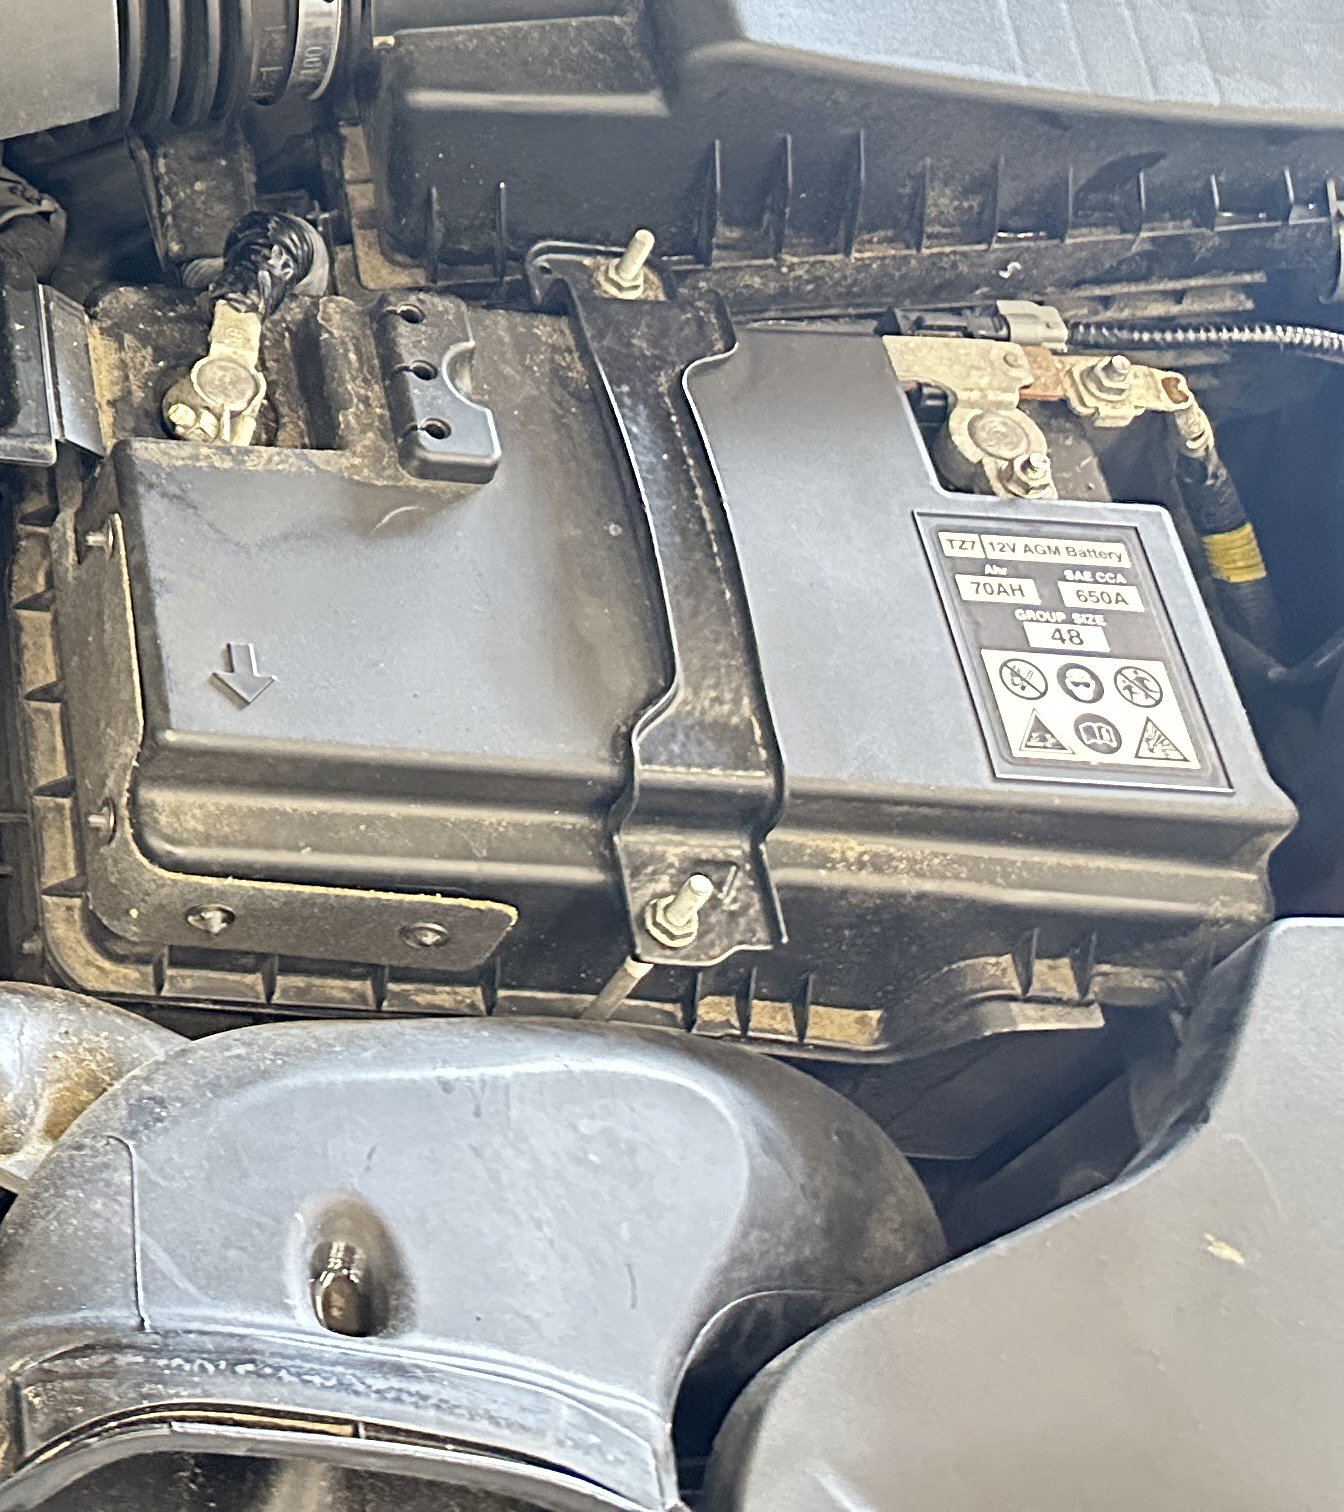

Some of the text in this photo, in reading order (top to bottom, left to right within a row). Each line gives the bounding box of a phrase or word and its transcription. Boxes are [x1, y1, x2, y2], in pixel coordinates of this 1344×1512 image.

[946, 538, 1123, 563] TZ7 12V AGM Battery
[1064, 569, 1128, 585] SAE CCA
[970, 581, 1026, 598] 70AH
[1075, 590, 1129, 606] 650A
[1015, 608, 1107, 627] GROUP SIZE
[1050, 627, 1085, 646] 48
